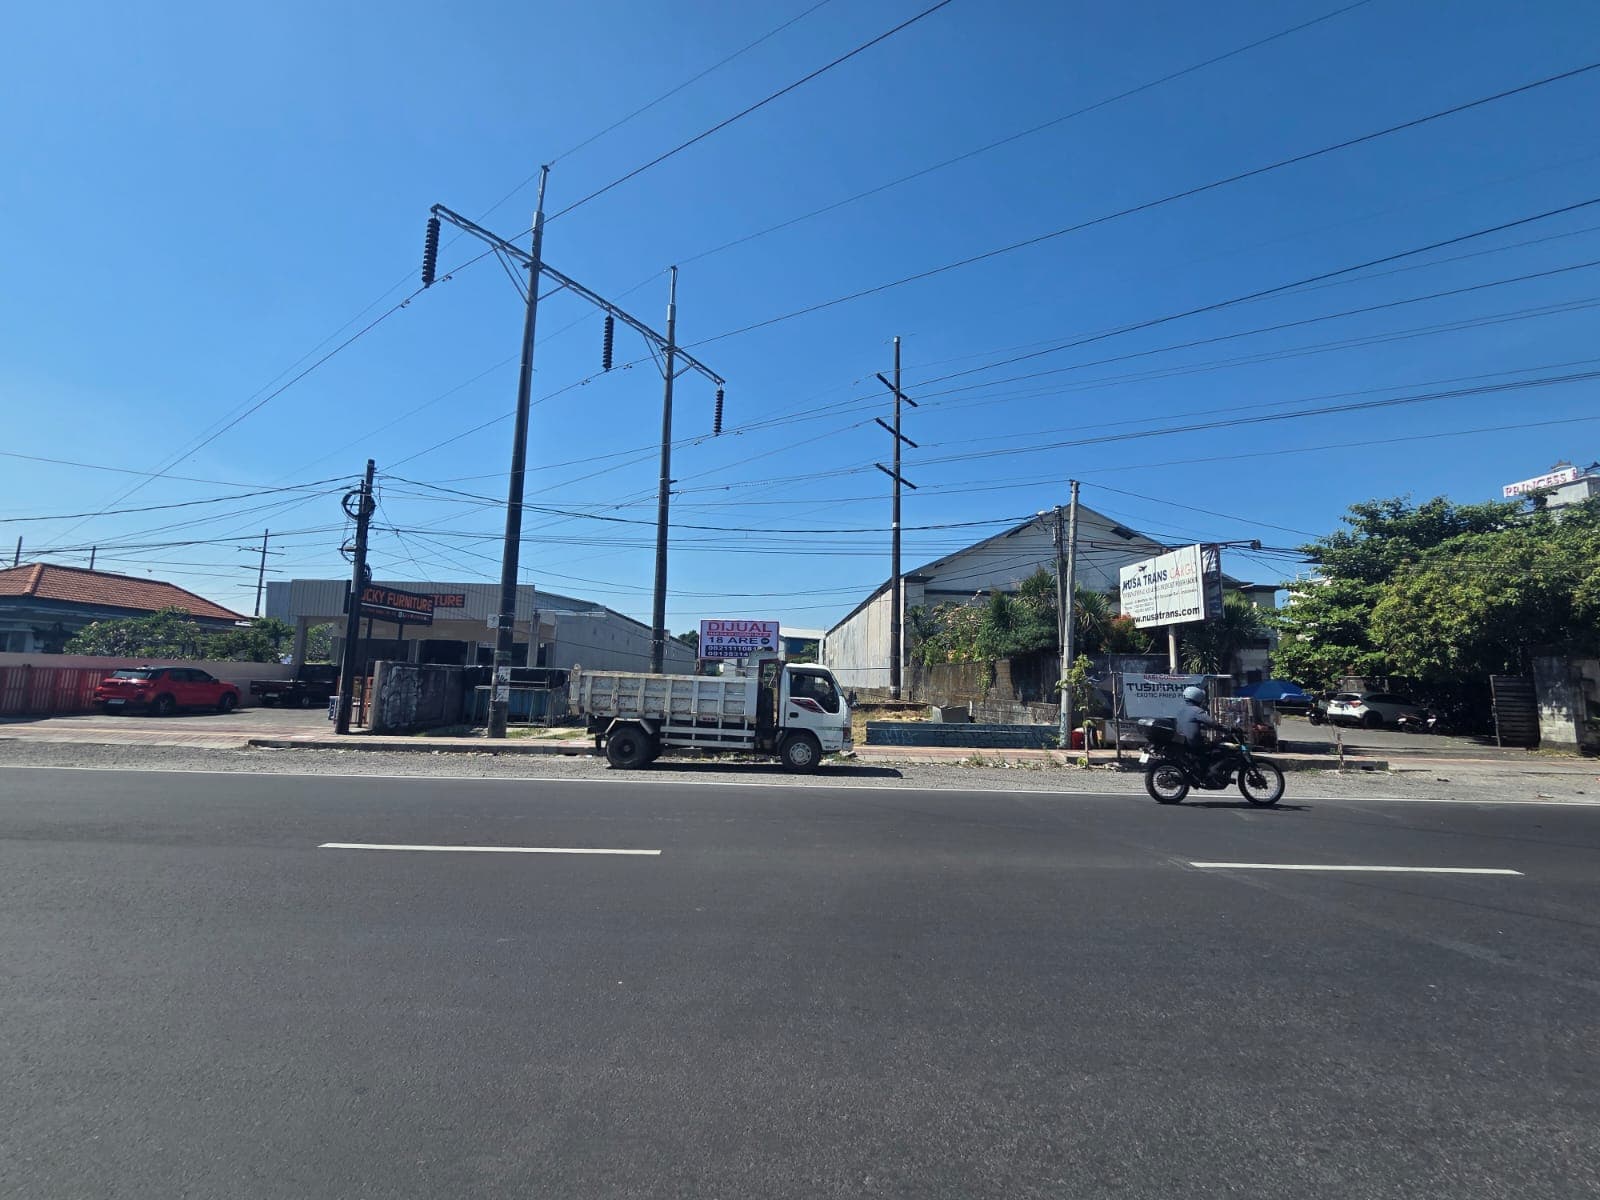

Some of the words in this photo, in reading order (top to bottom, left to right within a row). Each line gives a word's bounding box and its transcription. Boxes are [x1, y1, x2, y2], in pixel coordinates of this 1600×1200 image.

[1122, 576, 1142, 592] NUSA
[1143, 569, 1168, 586] TRANS
[387, 593, 433, 612] FURNITURE
[708, 622, 772, 632] DIJUAL
